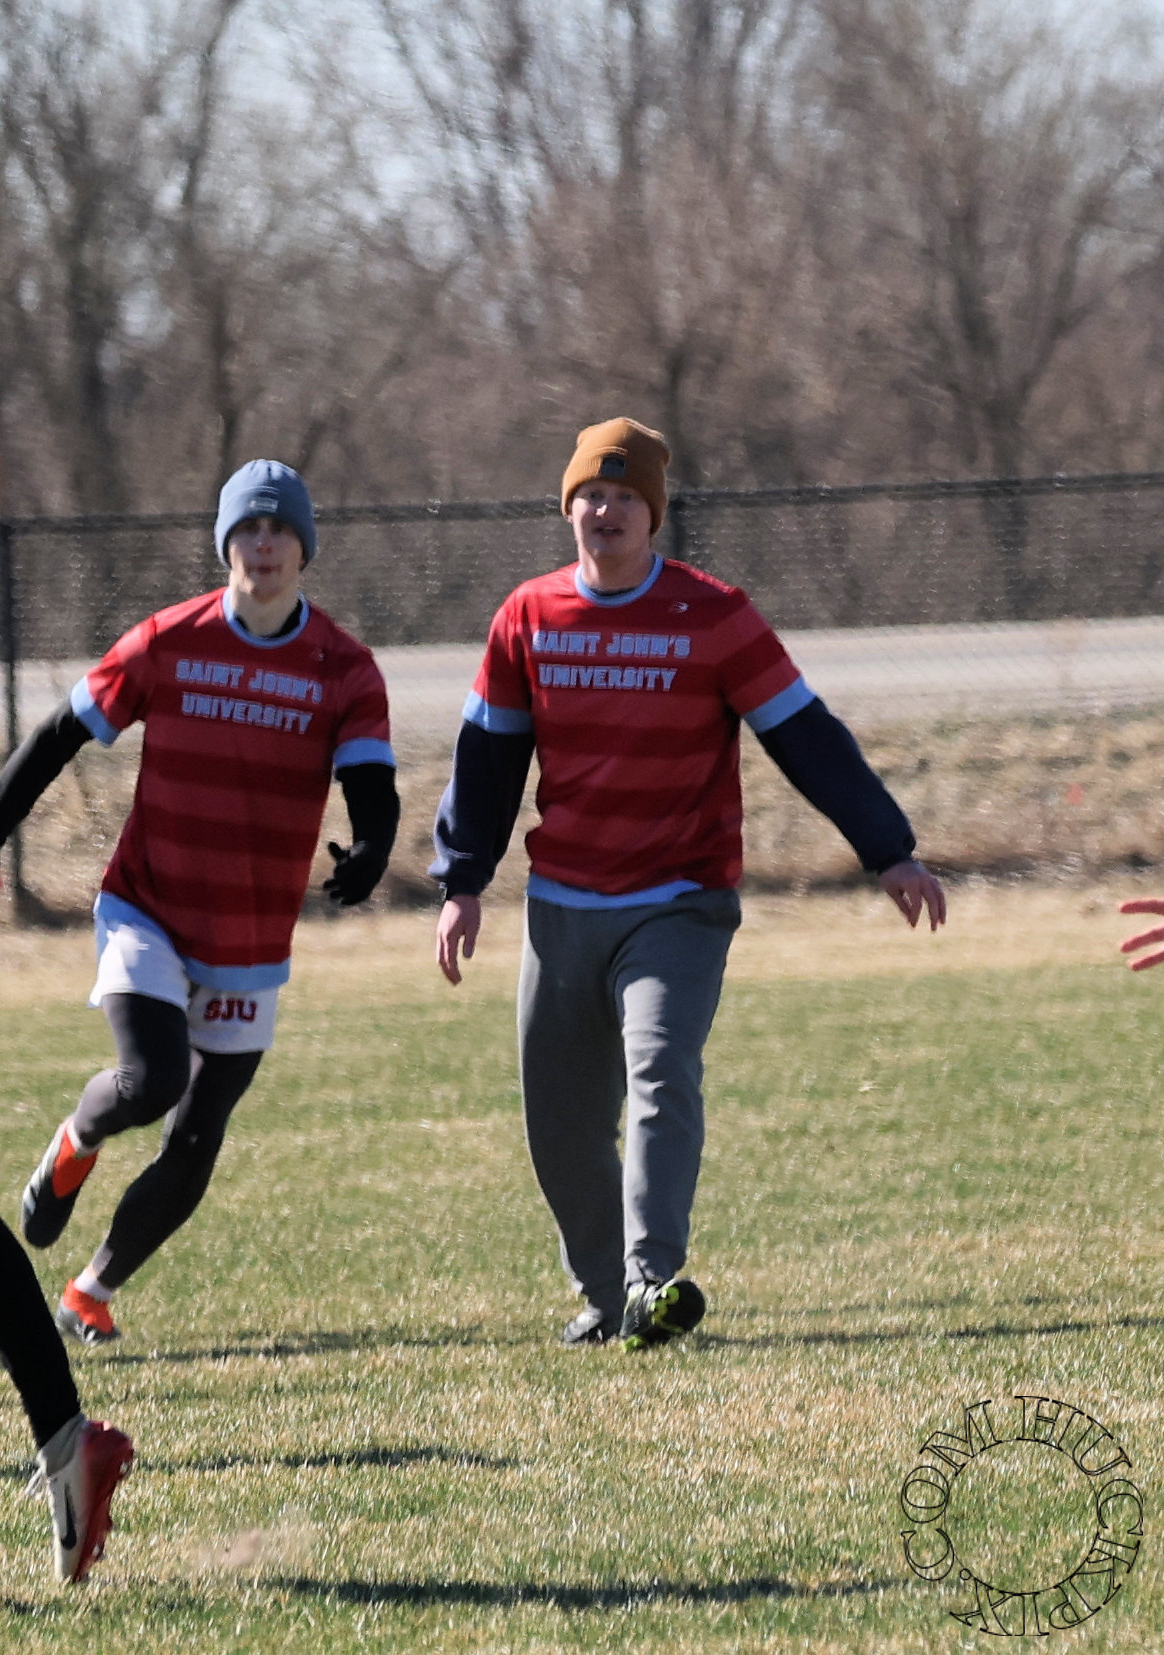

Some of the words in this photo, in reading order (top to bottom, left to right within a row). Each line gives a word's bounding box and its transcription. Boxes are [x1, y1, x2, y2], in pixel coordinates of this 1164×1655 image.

[532, 631, 601, 657] SAINT
[605, 632, 691, 659] JOHN'S
[175, 659, 244, 688] SAINT
[248, 668, 323, 704] JOHN'S
[538, 663, 678, 691] UNIVERSITY
[182, 692, 314, 734] UNIVERSITY
[204, 998, 257, 1023] SJU
